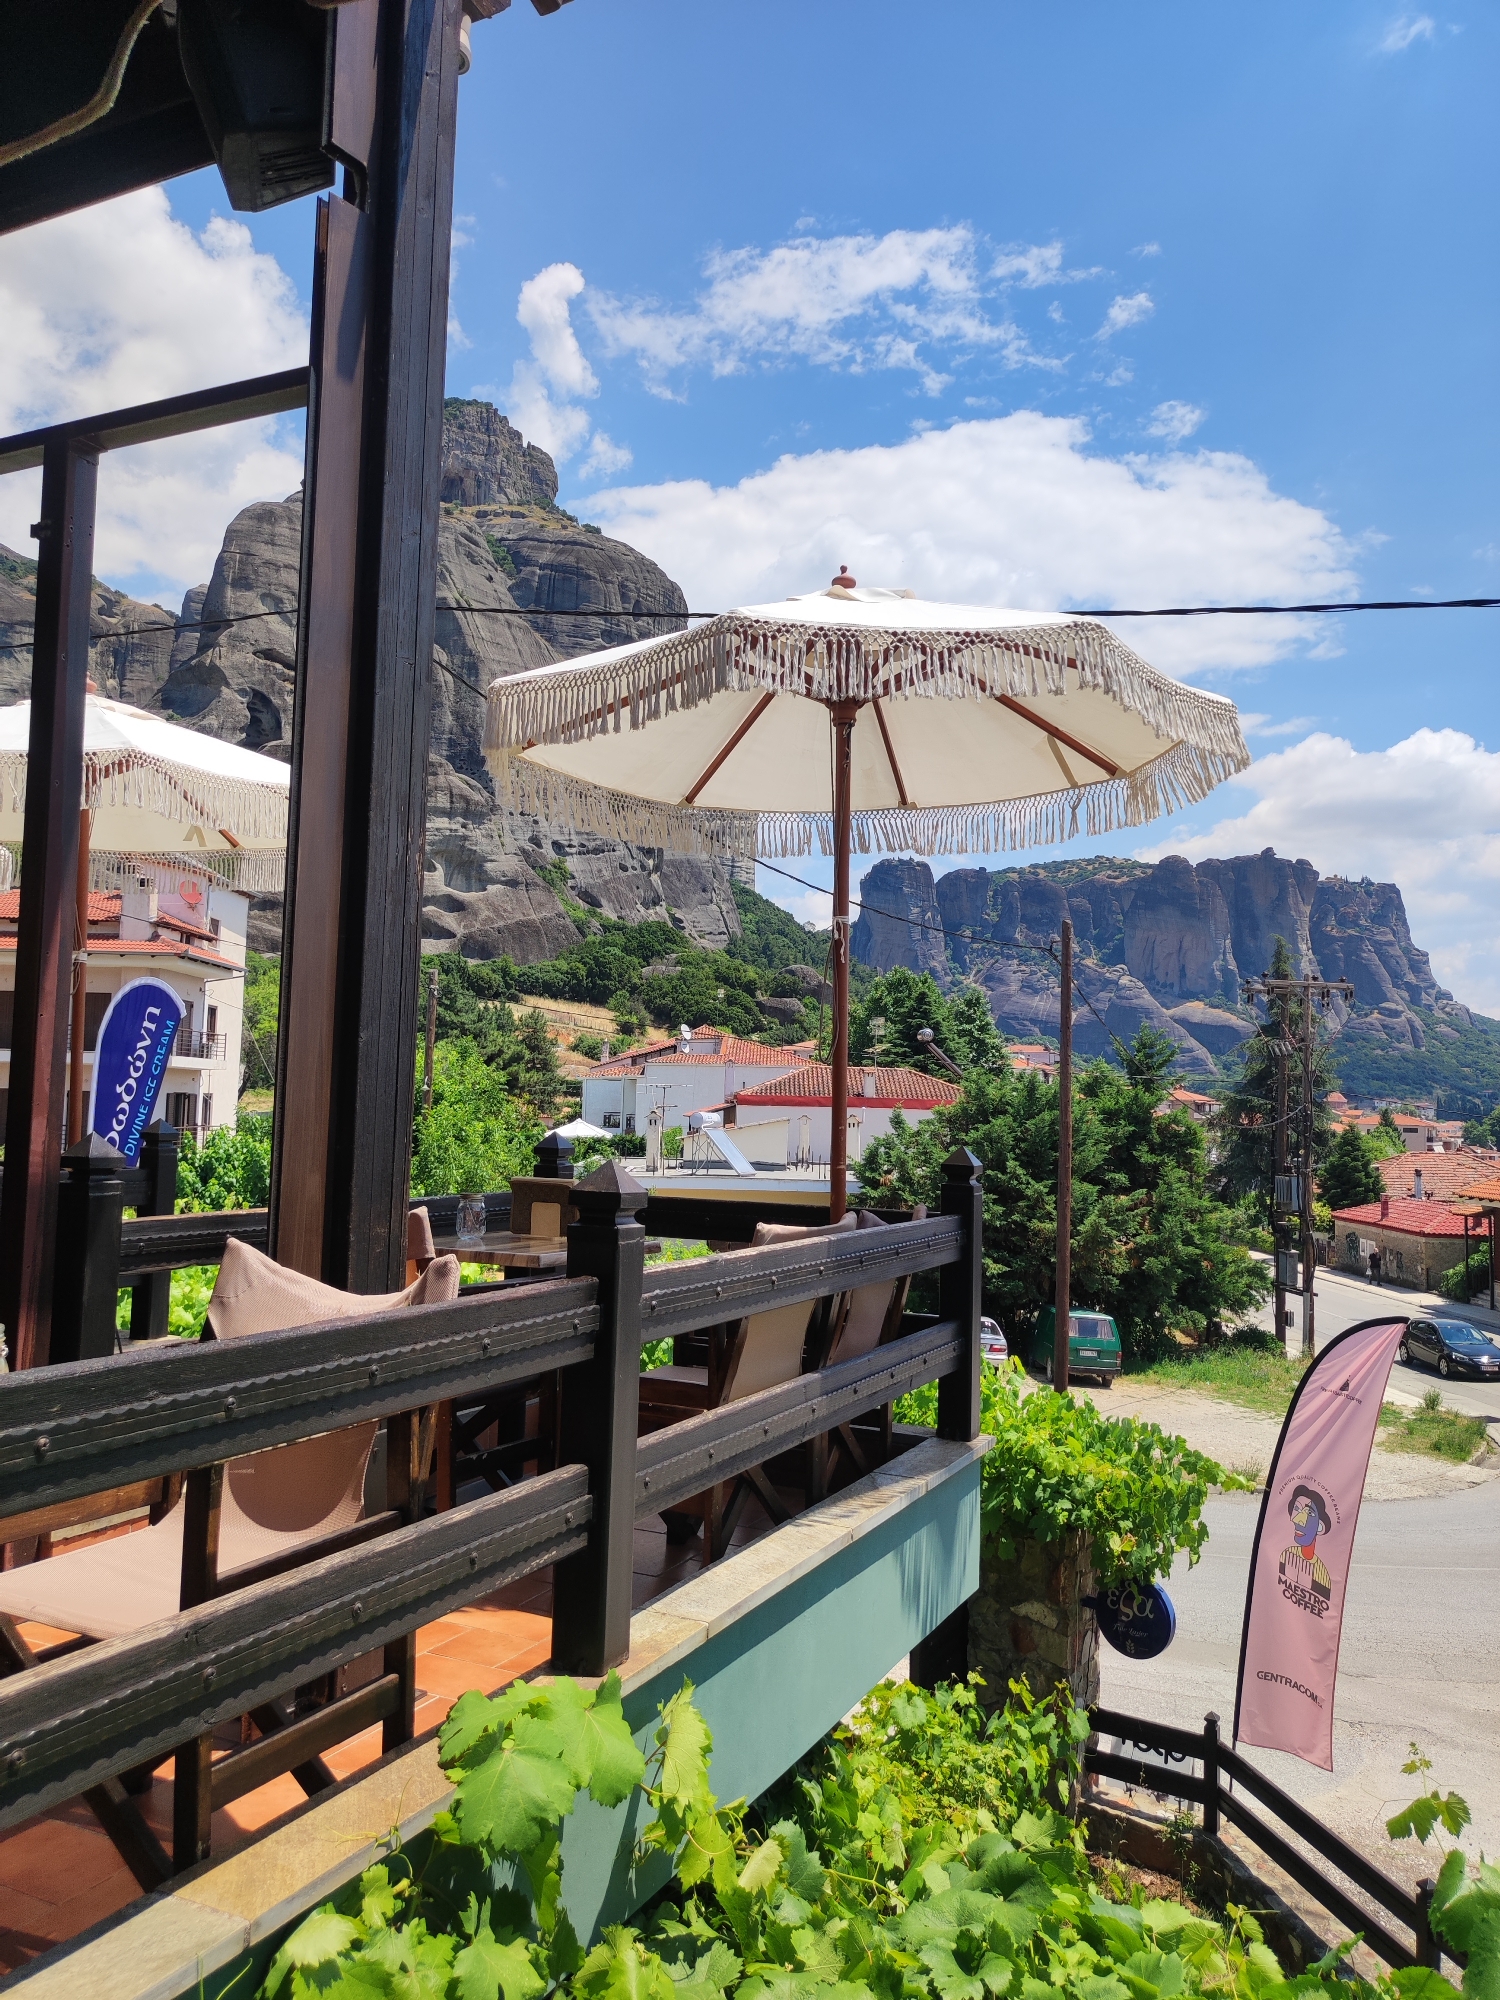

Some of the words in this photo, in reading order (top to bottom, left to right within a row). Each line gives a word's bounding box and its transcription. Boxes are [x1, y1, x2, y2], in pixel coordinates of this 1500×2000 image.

[124, 1105, 149, 1156] DIVINE
[143, 1077, 157, 1102] ICE
[151, 1019, 175, 1076] CREAM
[1277, 1574, 1330, 1612] MAESTRO
[1282, 1588, 1324, 1620] COFFEE
[1256, 1670, 1318, 1705] GENTRACOM
